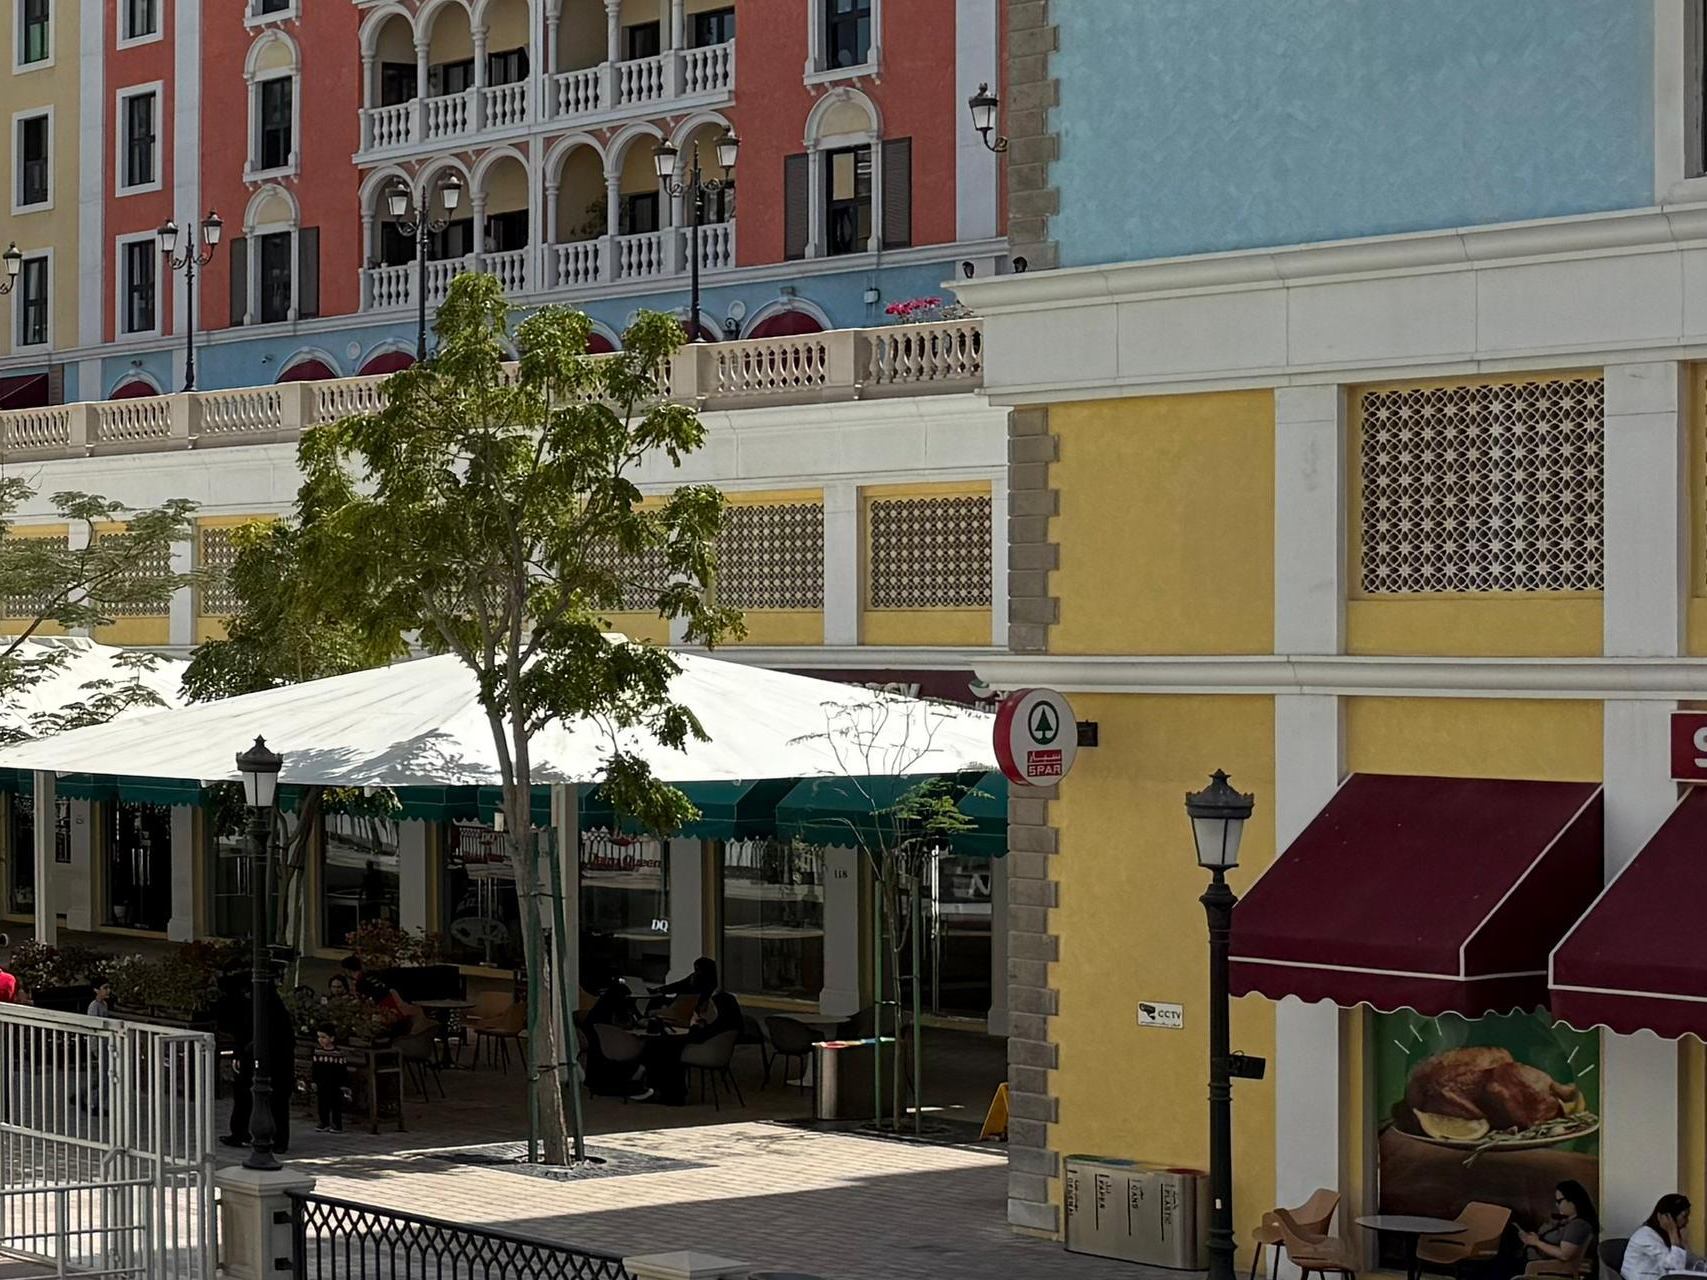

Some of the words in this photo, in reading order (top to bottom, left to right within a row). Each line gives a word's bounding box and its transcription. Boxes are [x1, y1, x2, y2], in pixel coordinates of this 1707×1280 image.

[1028, 765, 1061, 776] SPAR
[651, 919, 669, 932] DQ
[1158, 1010, 1181, 1019] CCTV
